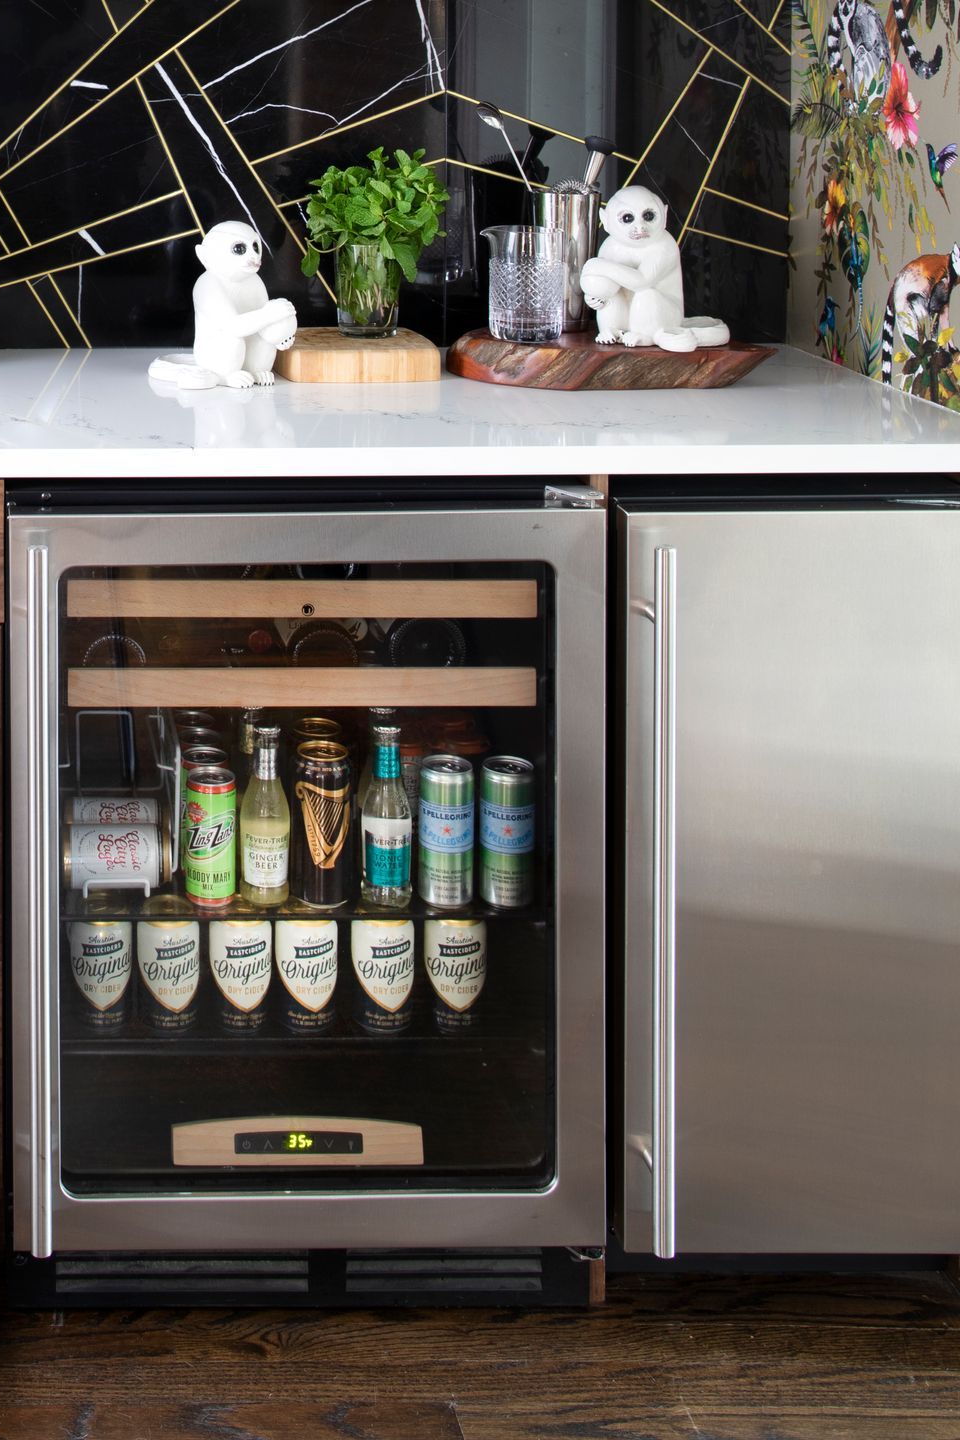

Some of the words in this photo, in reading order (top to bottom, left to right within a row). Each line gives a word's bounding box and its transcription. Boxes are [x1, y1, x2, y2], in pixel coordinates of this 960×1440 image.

[97, 833, 115, 872] Lager
[113, 836, 128, 868] City
[125, 830, 141, 871] Classic
[249, 851, 284, 862] GINGER
[255, 861, 278, 870] BEER
[212, 871, 231, 883] MARY
[202, 883, 214, 891] MIX
[86, 943, 121, 954] EASTCIDERS
[160, 943, 194, 957] EASTCIDERS
[229, 942, 265, 956] EASTCIDERS
[298, 942, 333, 956] EASTCIDERS
[375, 942, 409, 956] EASTCIDERS
[442, 943, 479, 955] EASTCIDERS
